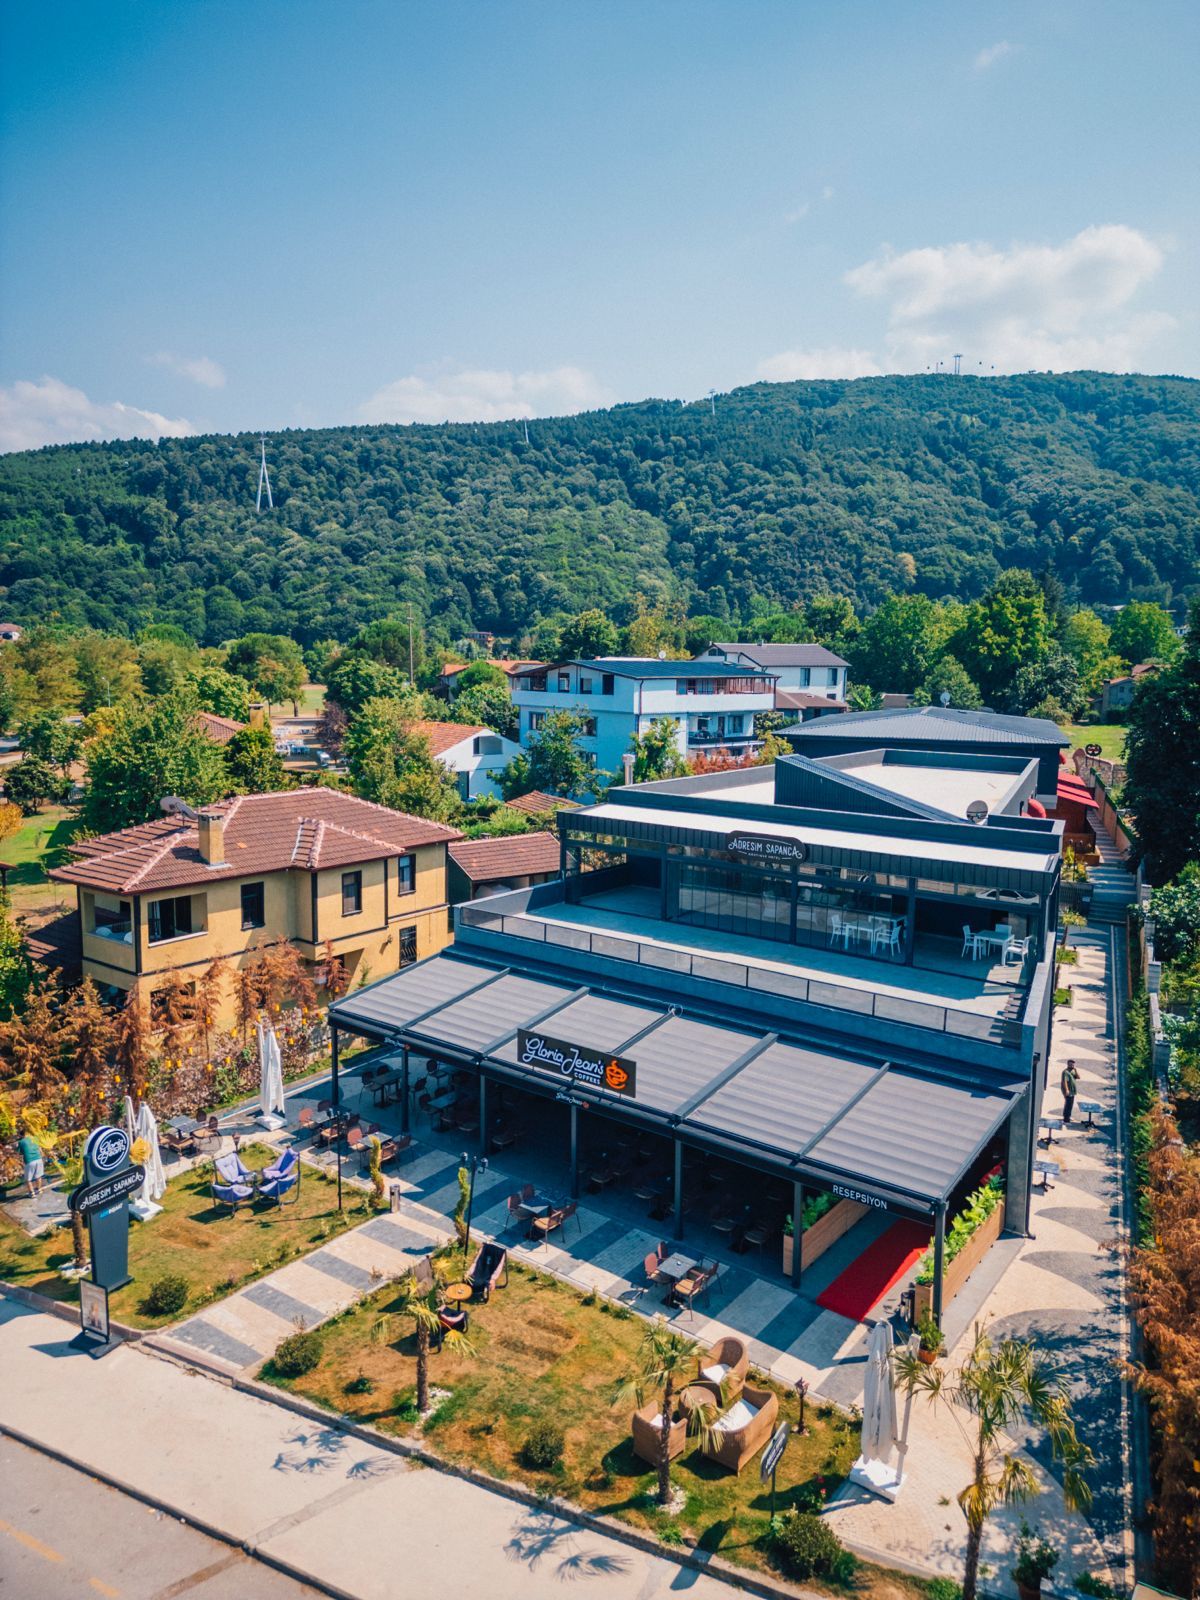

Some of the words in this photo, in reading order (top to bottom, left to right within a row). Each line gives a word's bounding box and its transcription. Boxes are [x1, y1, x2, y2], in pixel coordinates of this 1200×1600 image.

[766, 843, 803, 859] SAPANCA
[522, 1038, 564, 1066] Gloria
[561, 1047, 604, 1075] Jean's
[574, 1072, 601, 1084] COFFEES
[113, 1172, 144, 1192] SAPANCA
